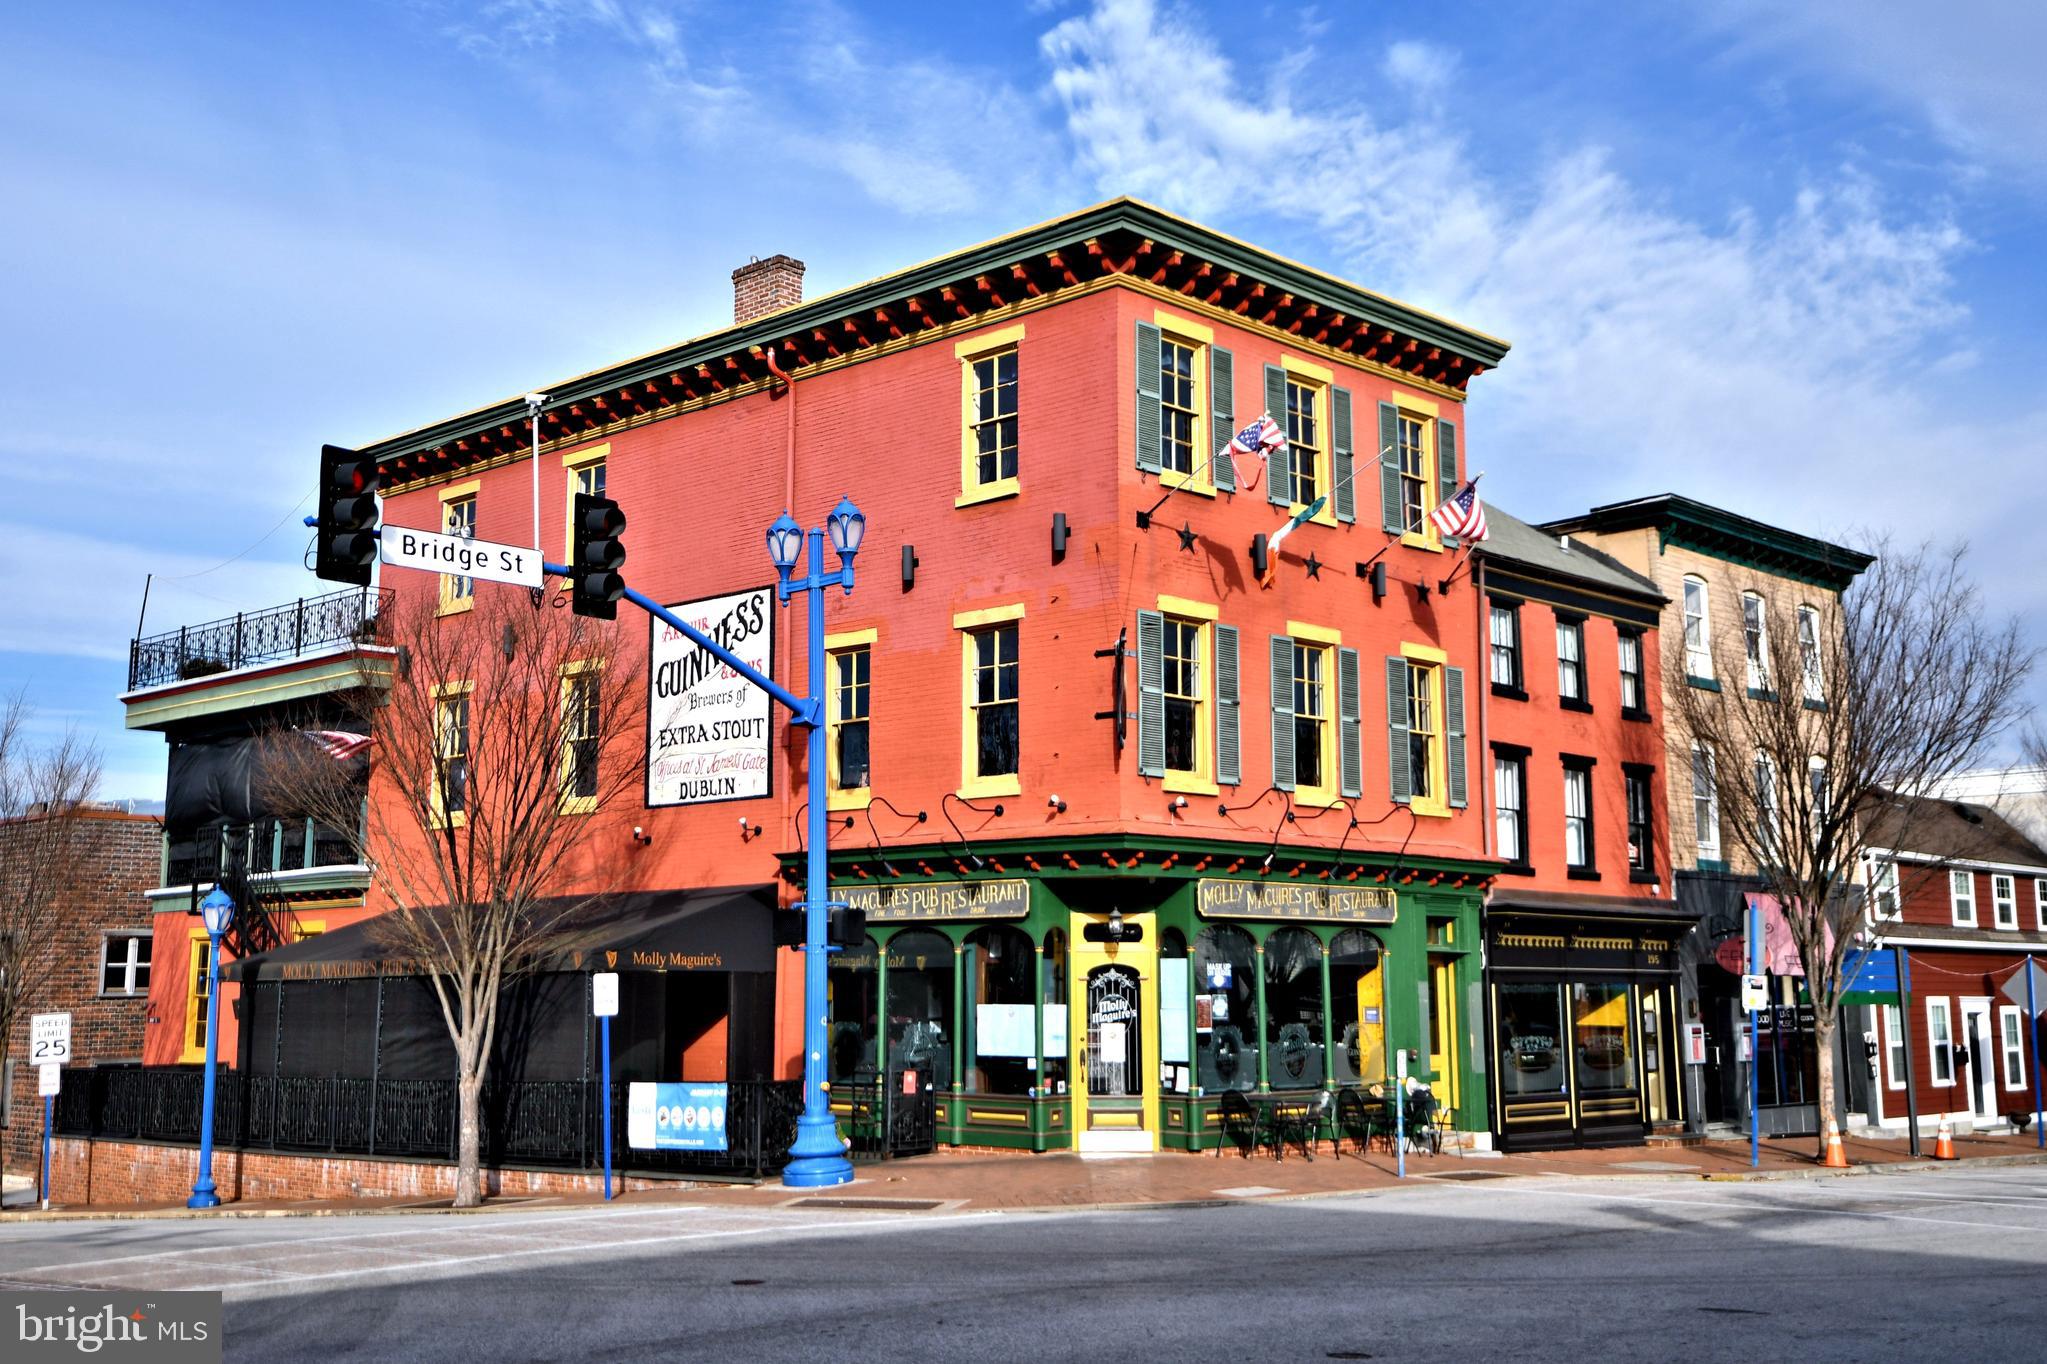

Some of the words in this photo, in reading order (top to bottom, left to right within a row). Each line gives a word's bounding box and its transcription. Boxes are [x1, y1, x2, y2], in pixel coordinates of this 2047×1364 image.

[402, 535, 489, 571] Bridge
[500, 551, 523, 574] St
[656, 594, 764, 699] GUINNESS
[688, 692, 733, 711] Brewers
[736, 682, 750, 709] of
[659, 724, 710, 751] EXTRA
[712, 717, 765, 741] STOUT
[743, 753, 767, 770] Gate
[679, 777, 736, 800] DUBLIN
[912, 887, 939, 914] PUB
[941, 883, 1023, 916] RESTAURANT
[1204, 884, 1245, 910] MOLLY
[1304, 889, 1329, 914] PUB
[1329, 891, 1391, 917] RESTAURANT
[283, 963, 317, 979] MOLLY
[382, 959, 404, 975] PUB
[633, 951, 667, 969] Molly
[670, 952, 722, 970] Maguire's
[1099, 999, 1128, 1013] Molly
[35, 1018, 68, 1028] SPEED
[38, 1029, 63, 1038] LIMIT
[35, 1040, 66, 1057] 25
